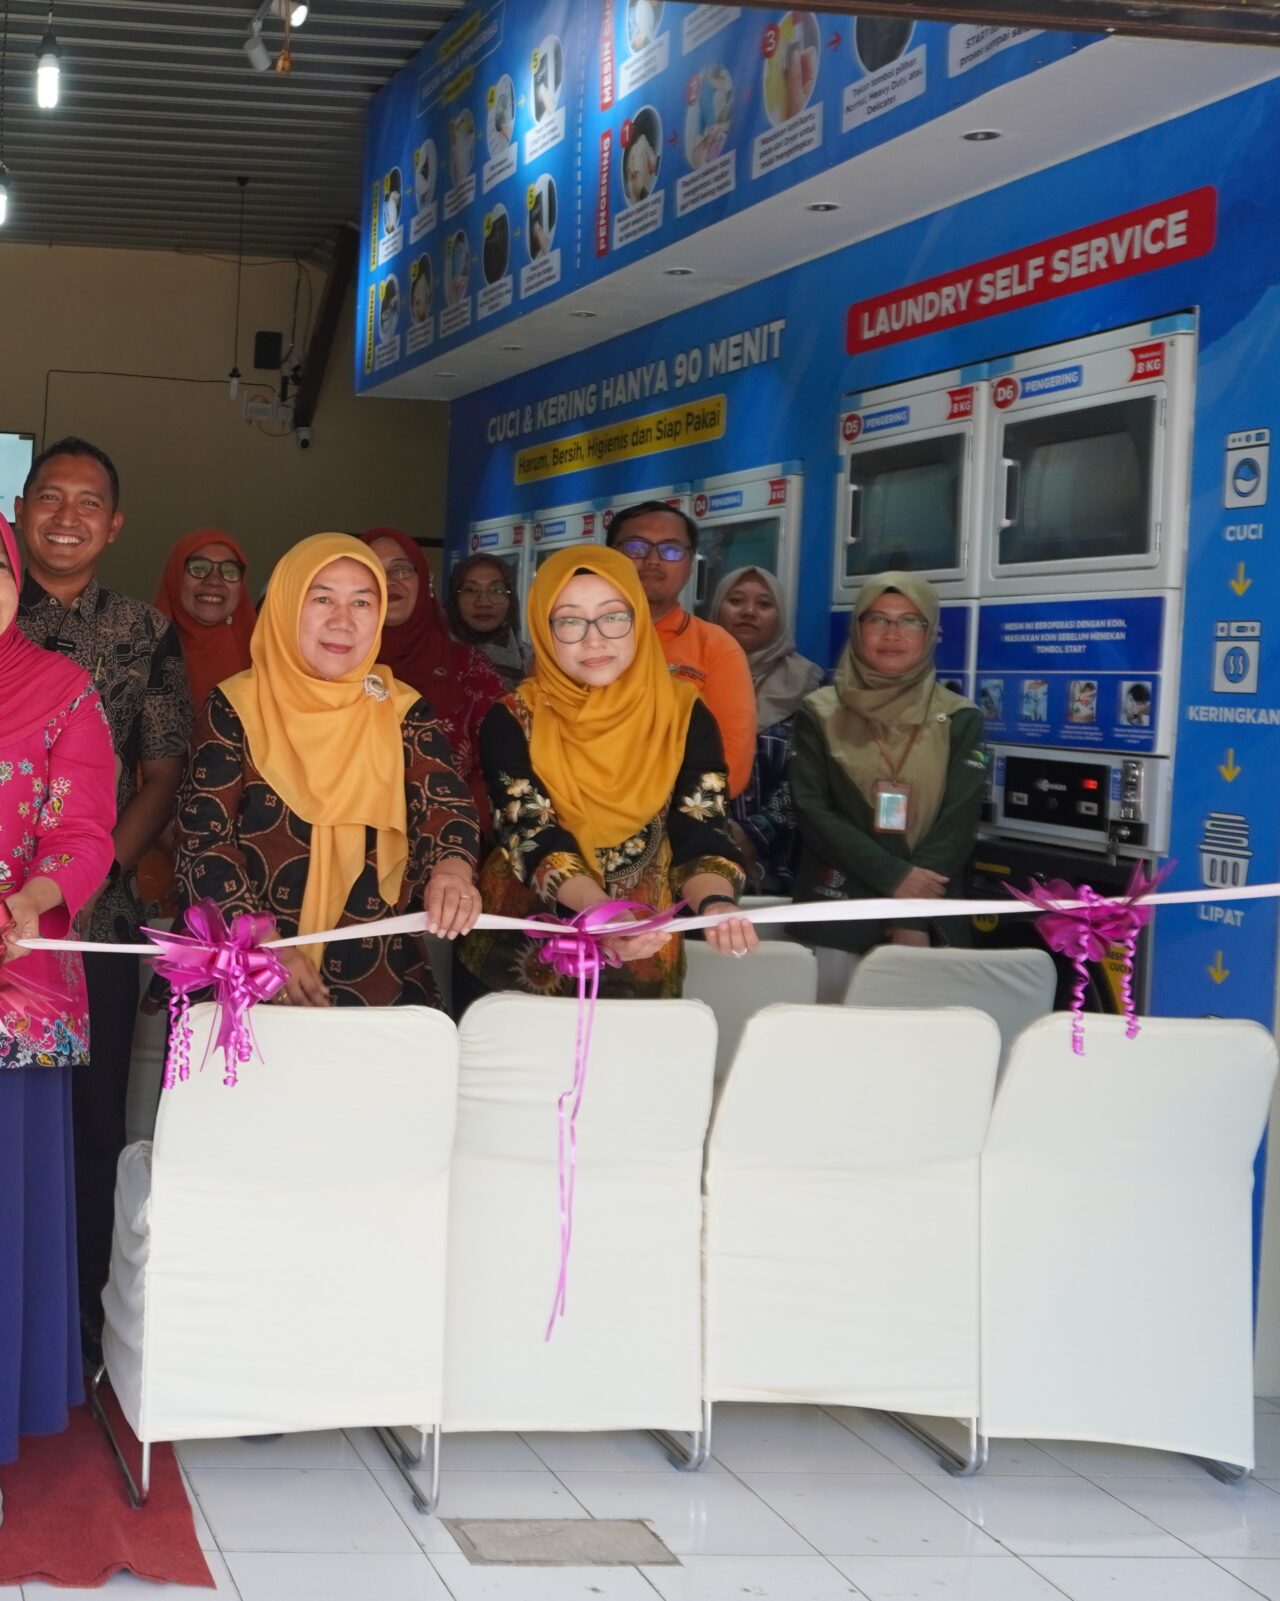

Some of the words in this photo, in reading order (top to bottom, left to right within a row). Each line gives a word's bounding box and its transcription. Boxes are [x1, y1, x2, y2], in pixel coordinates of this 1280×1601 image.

[765, 30, 776, 50] 3
[602, 41, 612, 103] MESIN
[599, 137, 610, 250] PENGERING
[861, 279, 974, 340] LAUNDRY
[977, 256, 1046, 306] SELF
[1050, 210, 1189, 284] SERVICE
[1137, 363, 1144, 374] 8
[1146, 359, 1161, 371] KG
[488, 411, 520, 444] CUCI
[523, 413, 534, 434] &
[537, 384, 598, 429] KERING
[601, 360, 668, 411] HANYA
[674, 348, 702, 388] 90
[708, 319, 787, 378] MENIT
[1025, 371, 1079, 393] PENGERING
[997, 386, 1014, 401] D6
[960, 401, 971, 411] KG
[845, 422, 858, 435] D5
[866, 412, 907, 428] PENGERING
[518, 454, 551, 474] Harum,
[552, 439, 586, 468] Bersih,
[587, 430, 628, 460] Higienis
[631, 422, 653, 446] dan
[656, 417, 682, 443] Siap
[685, 402, 721, 433] Pakai
[695, 500, 706, 511] D4
[1225, 524, 1263, 541] CUCI
[1076, 620, 1106, 628] DENGAN
[1040, 633, 1057, 641] KOIN
[1065, 645, 1087, 653] START
[1188, 705, 1280, 725] KERINGKAN
[1200, 905, 1245, 927] LIPAT
